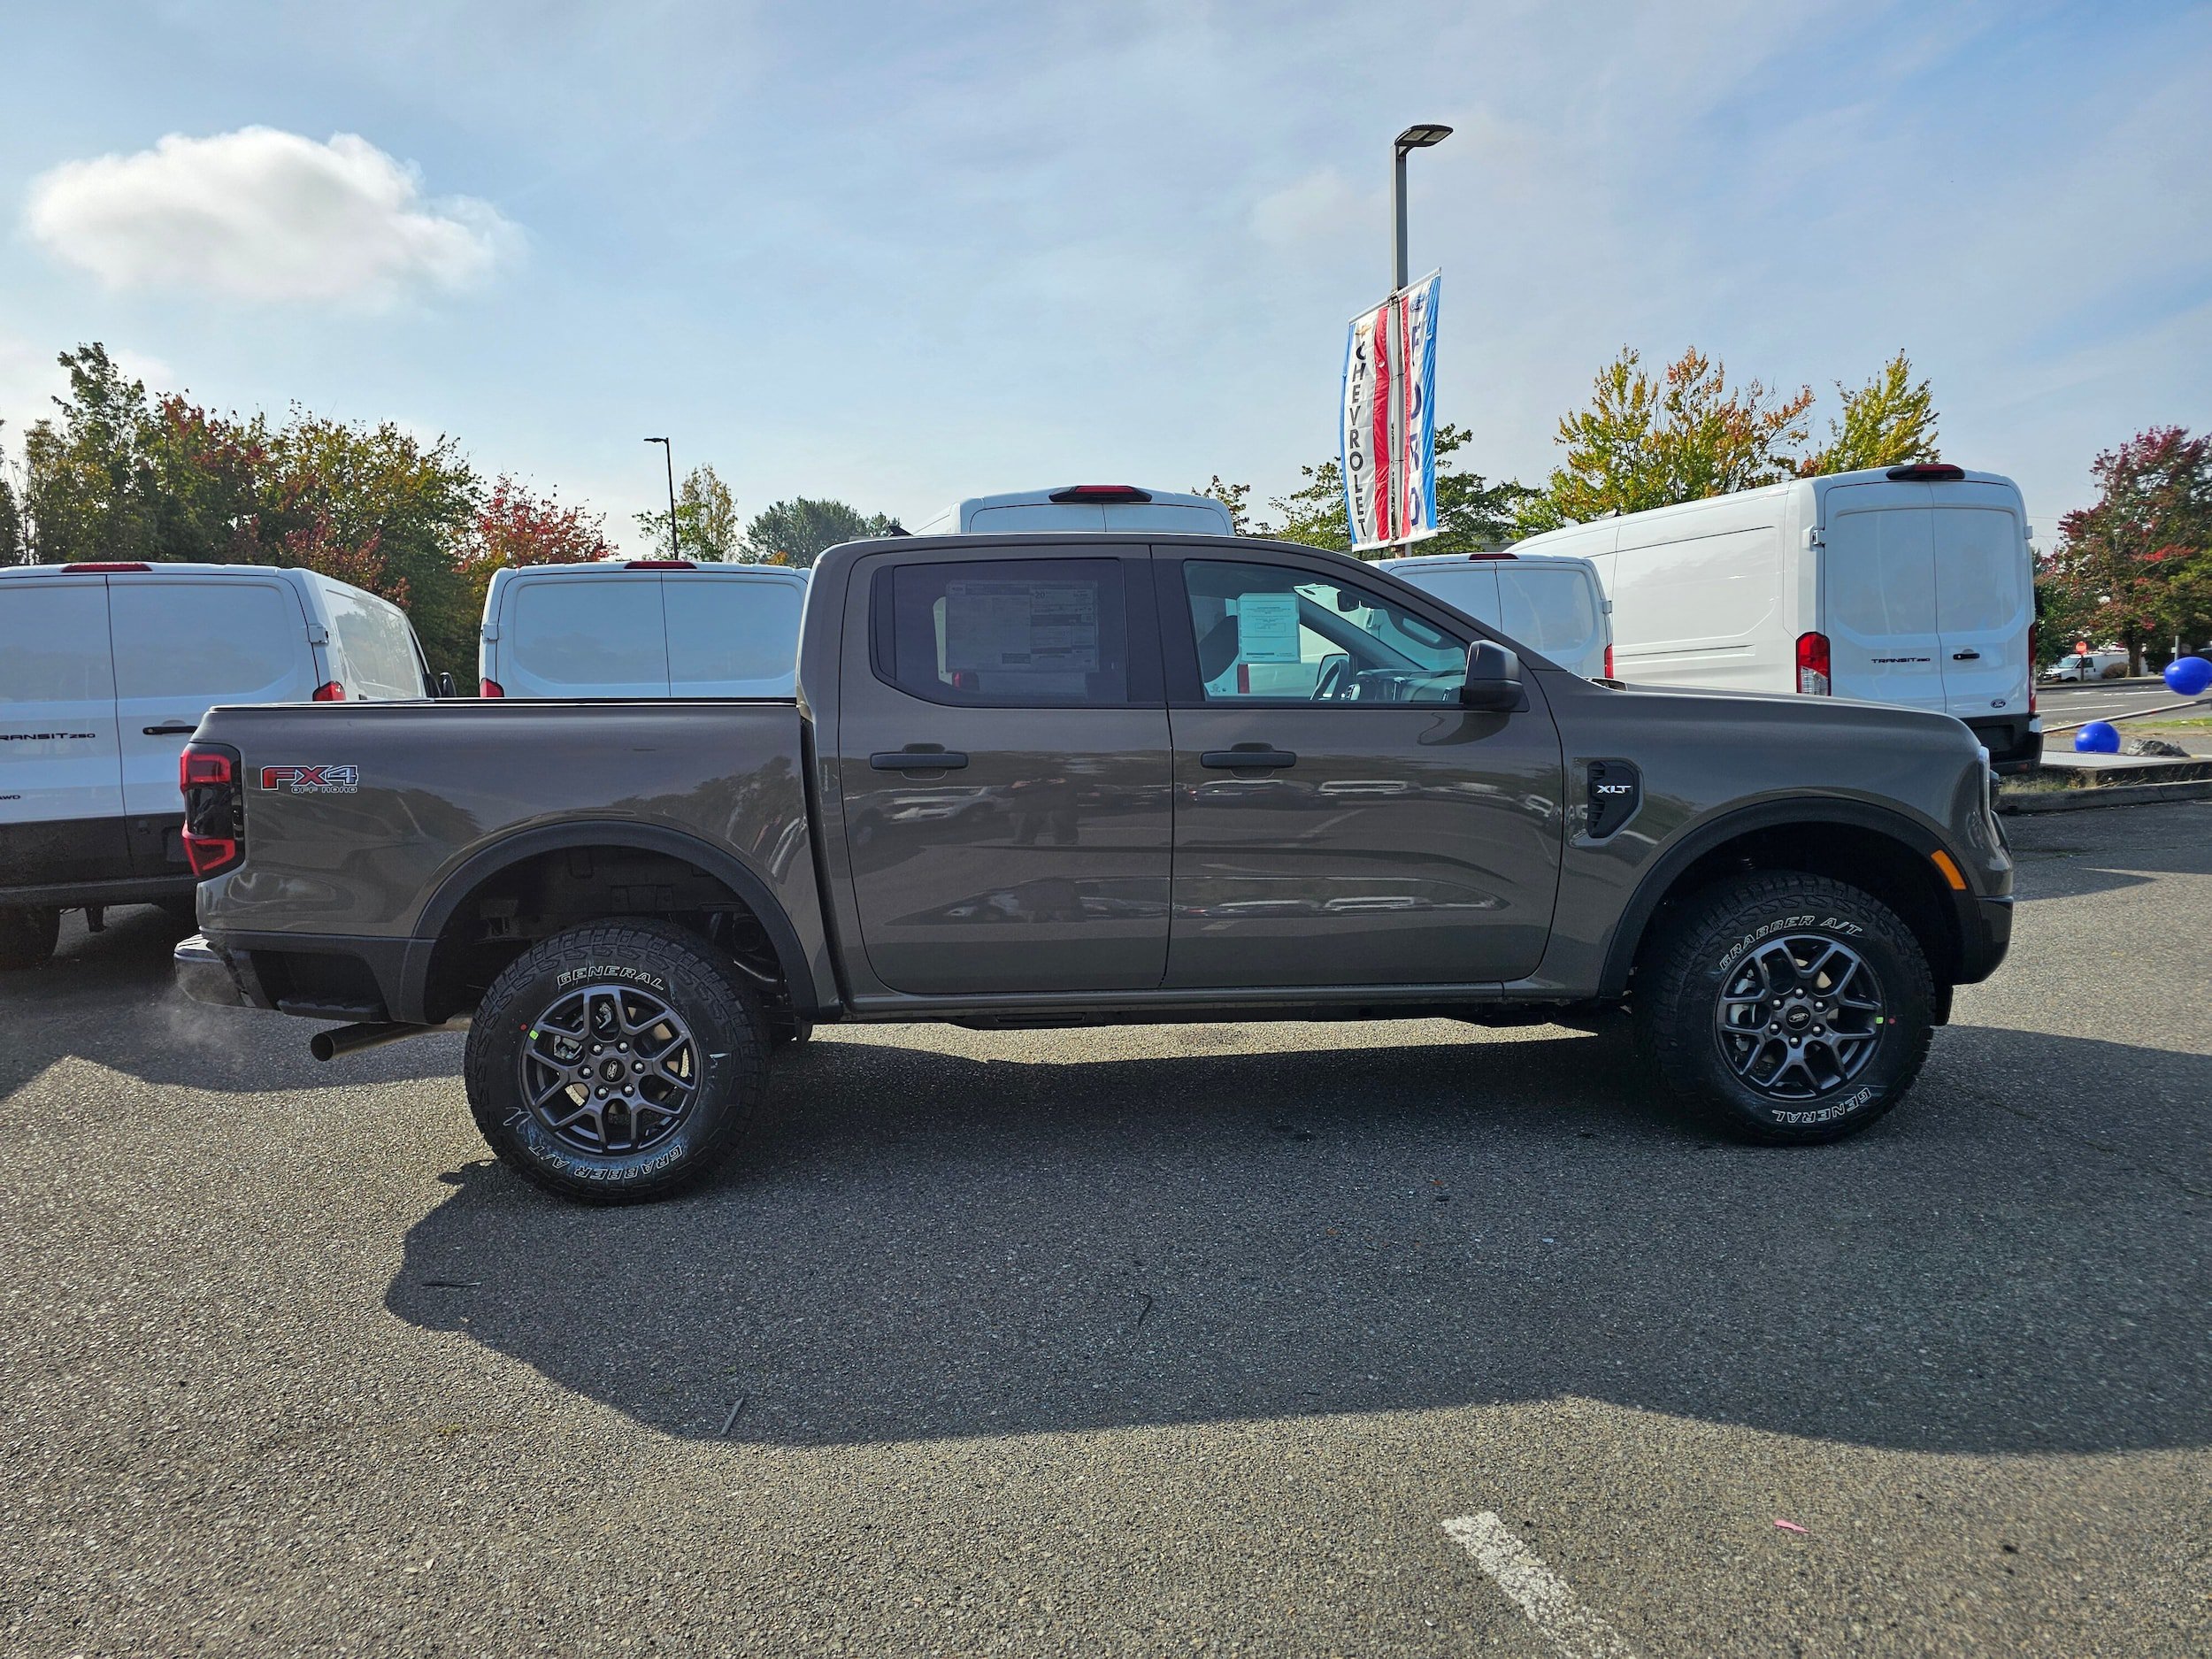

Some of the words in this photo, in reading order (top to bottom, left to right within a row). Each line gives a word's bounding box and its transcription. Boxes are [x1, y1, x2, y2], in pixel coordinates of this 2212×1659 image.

[1349, 341, 1367, 537] CHEVROLET
[261, 765, 358, 790] FX4
[1596, 785, 1632, 794] XLT
[1719, 915, 1815, 972] GRABBER
[1820, 917, 1863, 935] A/T
[557, 965, 664, 991] GENERAL
[1771, 1087, 1870, 1124] GENERAL
[527, 1145, 571, 1169] A/T
[573, 1144, 683, 1180] GRABBER
